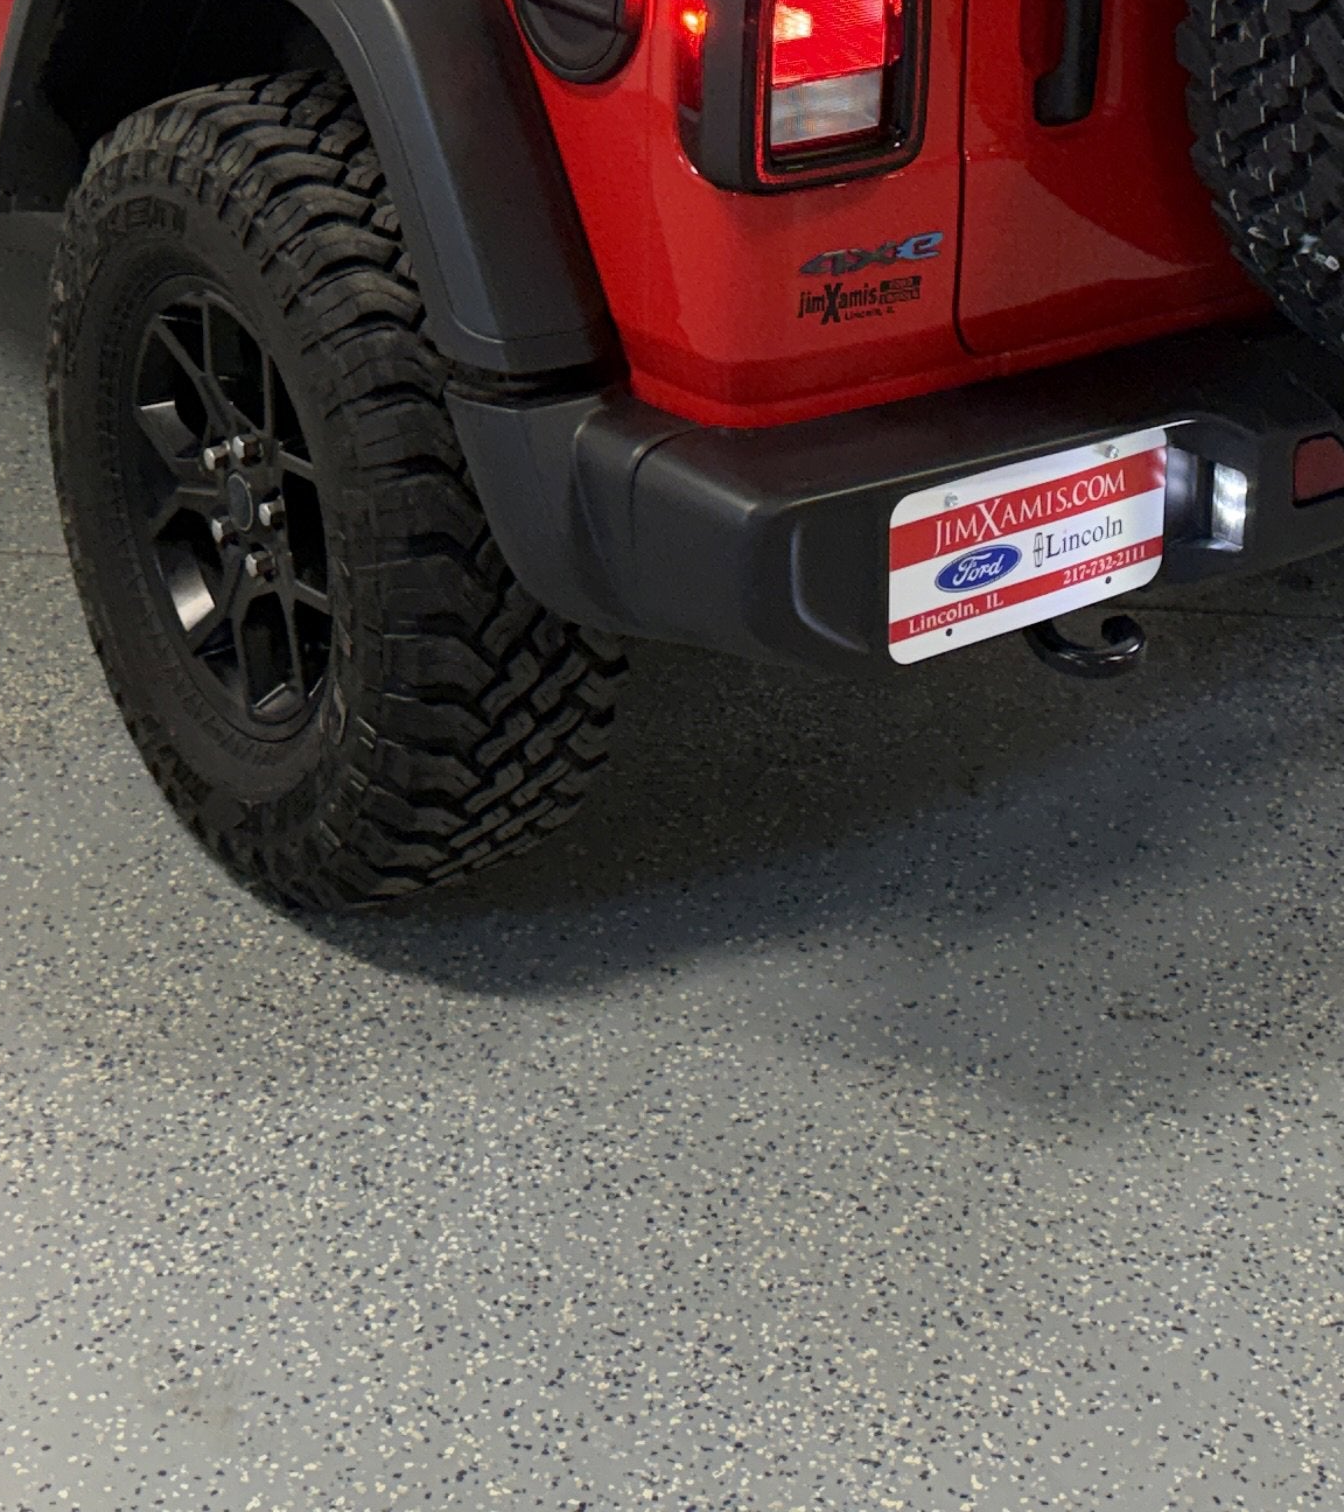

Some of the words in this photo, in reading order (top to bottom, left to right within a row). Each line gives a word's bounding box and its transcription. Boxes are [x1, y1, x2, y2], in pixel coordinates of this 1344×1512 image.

[934, 468, 1126, 556] JIMXAMIS.COM
[1045, 515, 1124, 559] Lincoln
[951, 551, 1006, 587] Ford
[1062, 544, 1147, 586] 217-732-2111
[908, 602, 981, 635] Lincoln,
[985, 593, 1005, 610] IL
